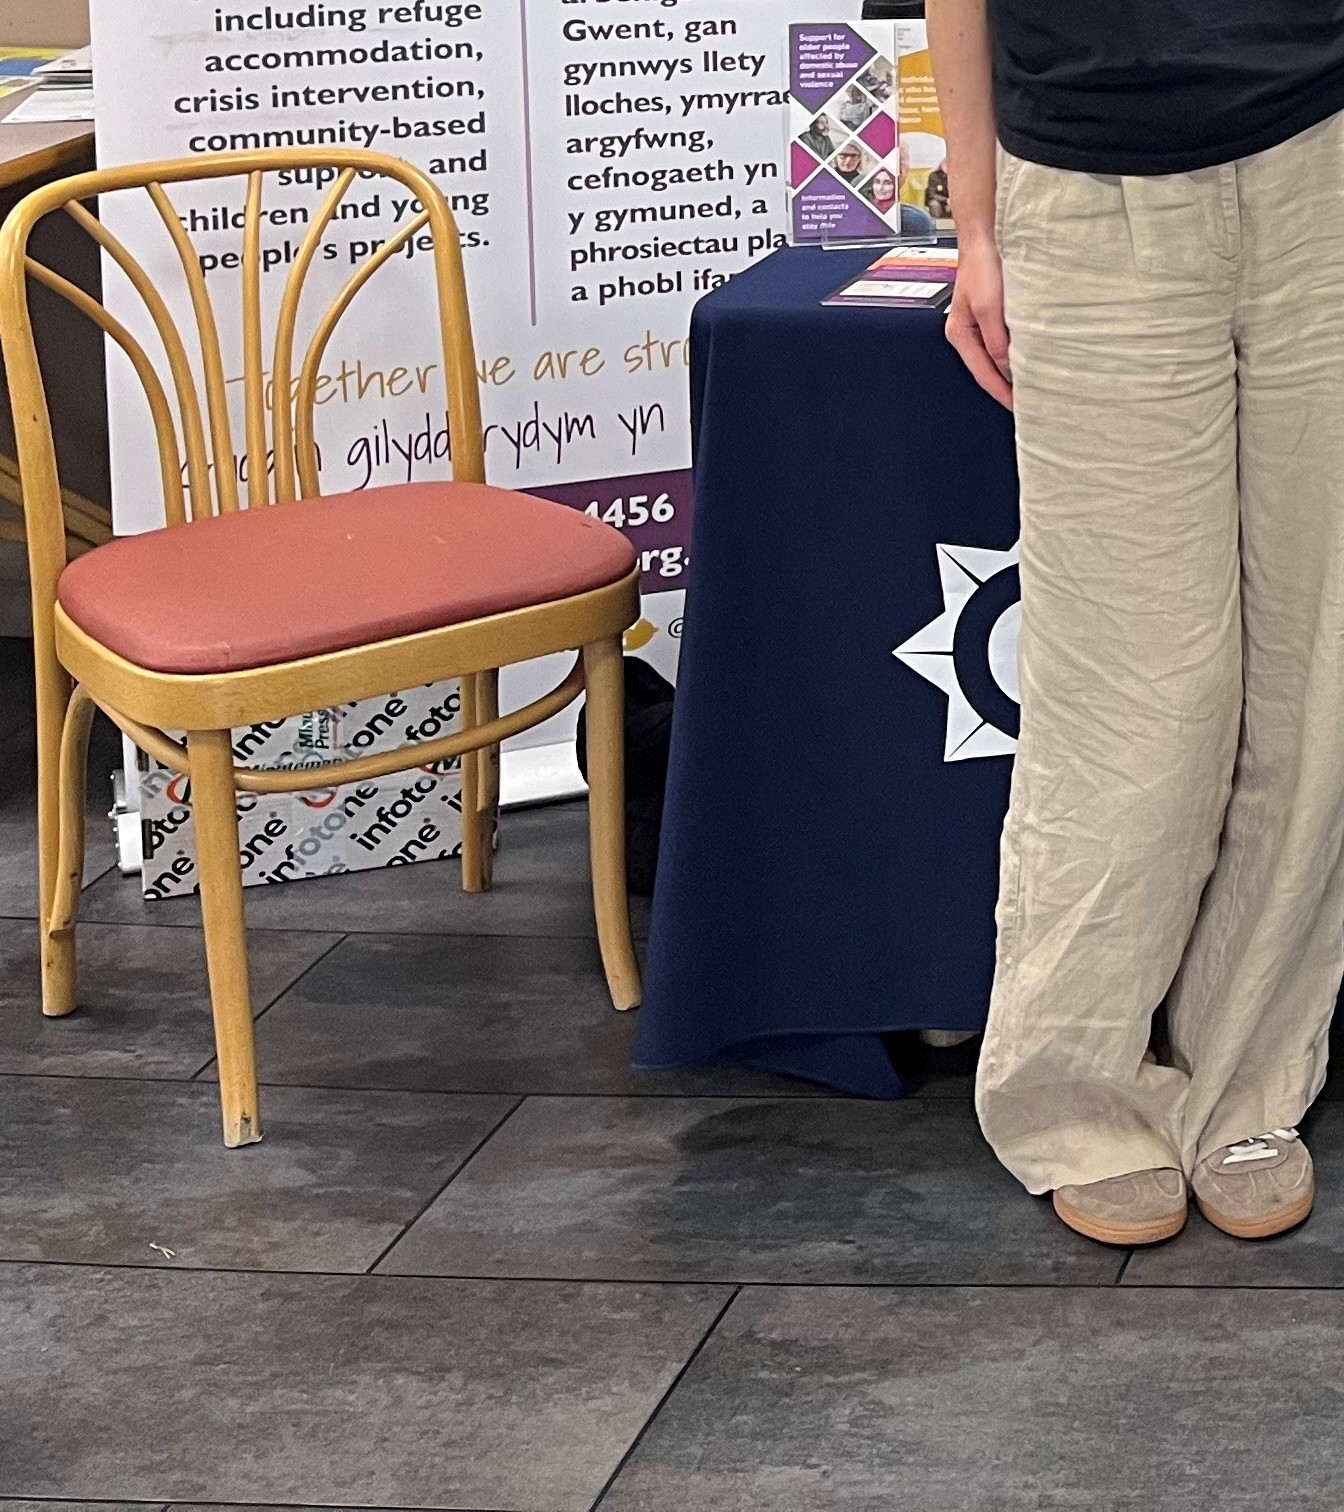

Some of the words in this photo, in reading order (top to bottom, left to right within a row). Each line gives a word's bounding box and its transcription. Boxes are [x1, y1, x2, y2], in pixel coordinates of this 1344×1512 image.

[215, 4, 367, 32] including
[379, 0, 482, 27] refuge
[562, 19, 674, 42] Gwent,
[685, 17, 737, 43] gan
[205, 37, 483, 73] accommodation,
[563, 56, 693, 86] gynnwys
[703, 50, 766, 81] llety
[174, 87, 259, 113] crisis
[272, 76, 485, 108] intervention,
[565, 92, 671, 117] lloches,
[189, 112, 486, 153] community-based
[566, 128, 714, 158] argyfwng,
[567, 159, 734, 191] cefnogaeth
[743, 160, 778, 183] yn
[481, 401, 596, 470] rydym
[617, 400, 666, 456] yn
